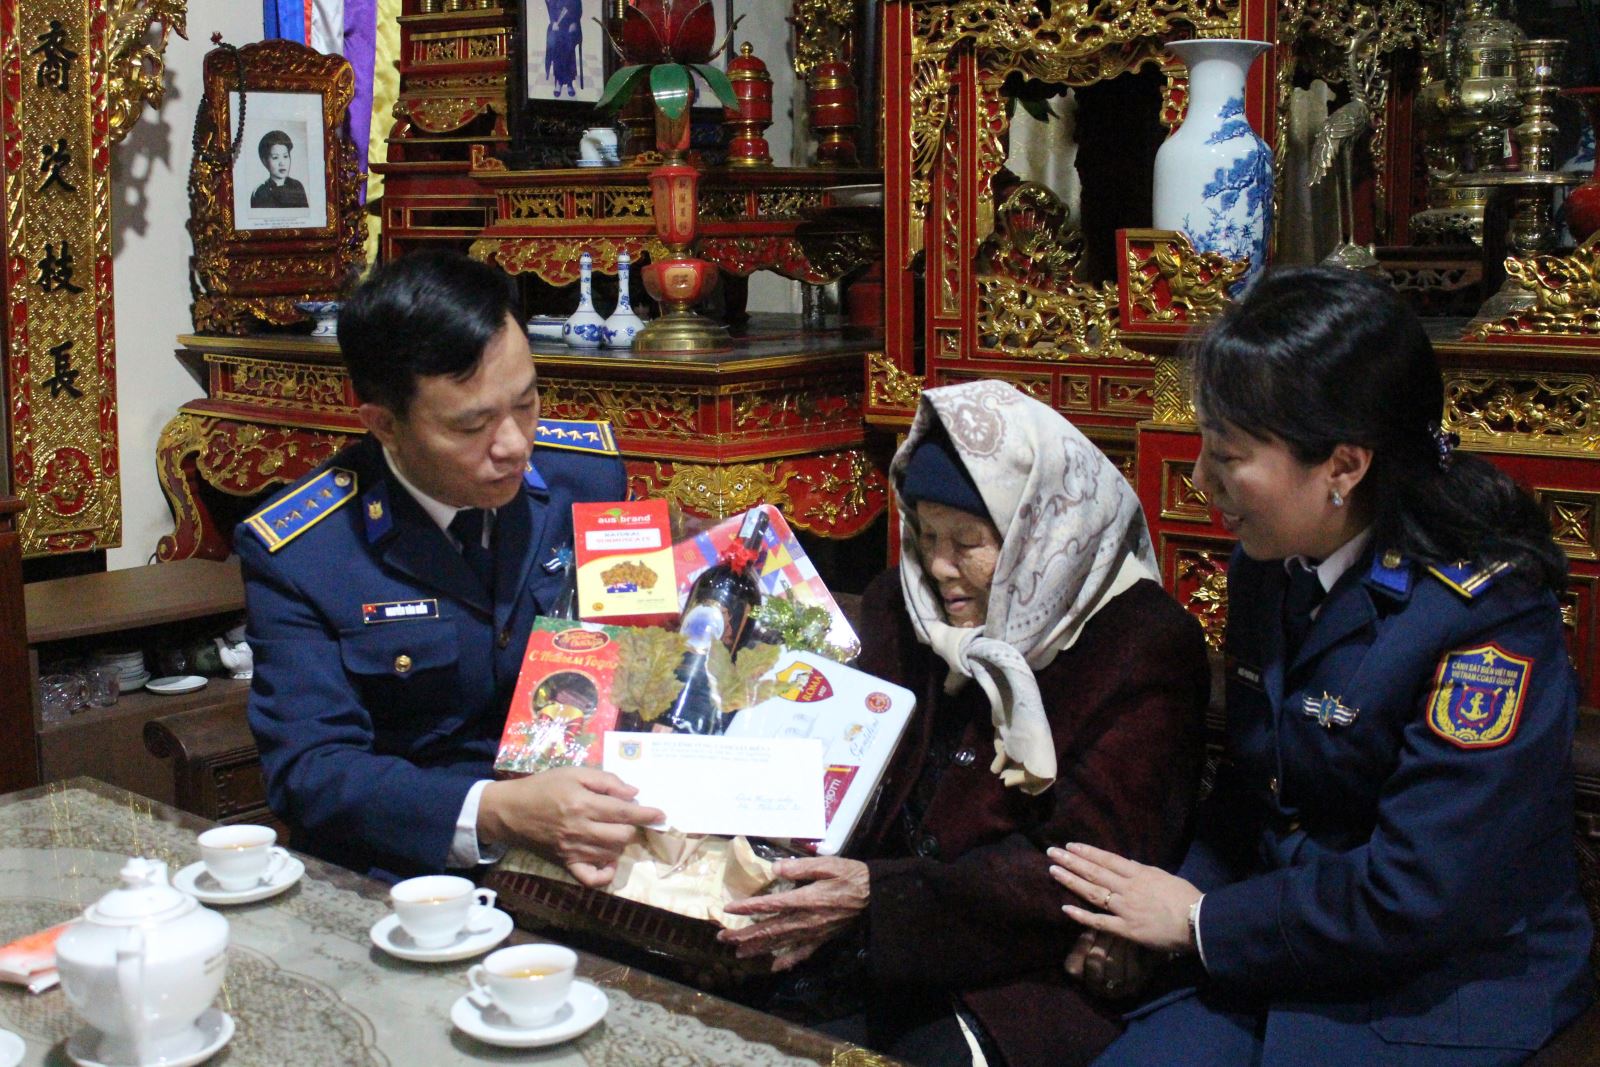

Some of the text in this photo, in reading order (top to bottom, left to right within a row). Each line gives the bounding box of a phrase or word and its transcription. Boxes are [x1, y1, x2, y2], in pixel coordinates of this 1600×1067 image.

[620, 514, 651, 523] brand
[1477, 674, 1496, 684] COAST
[803, 675, 824, 700] ROMA
